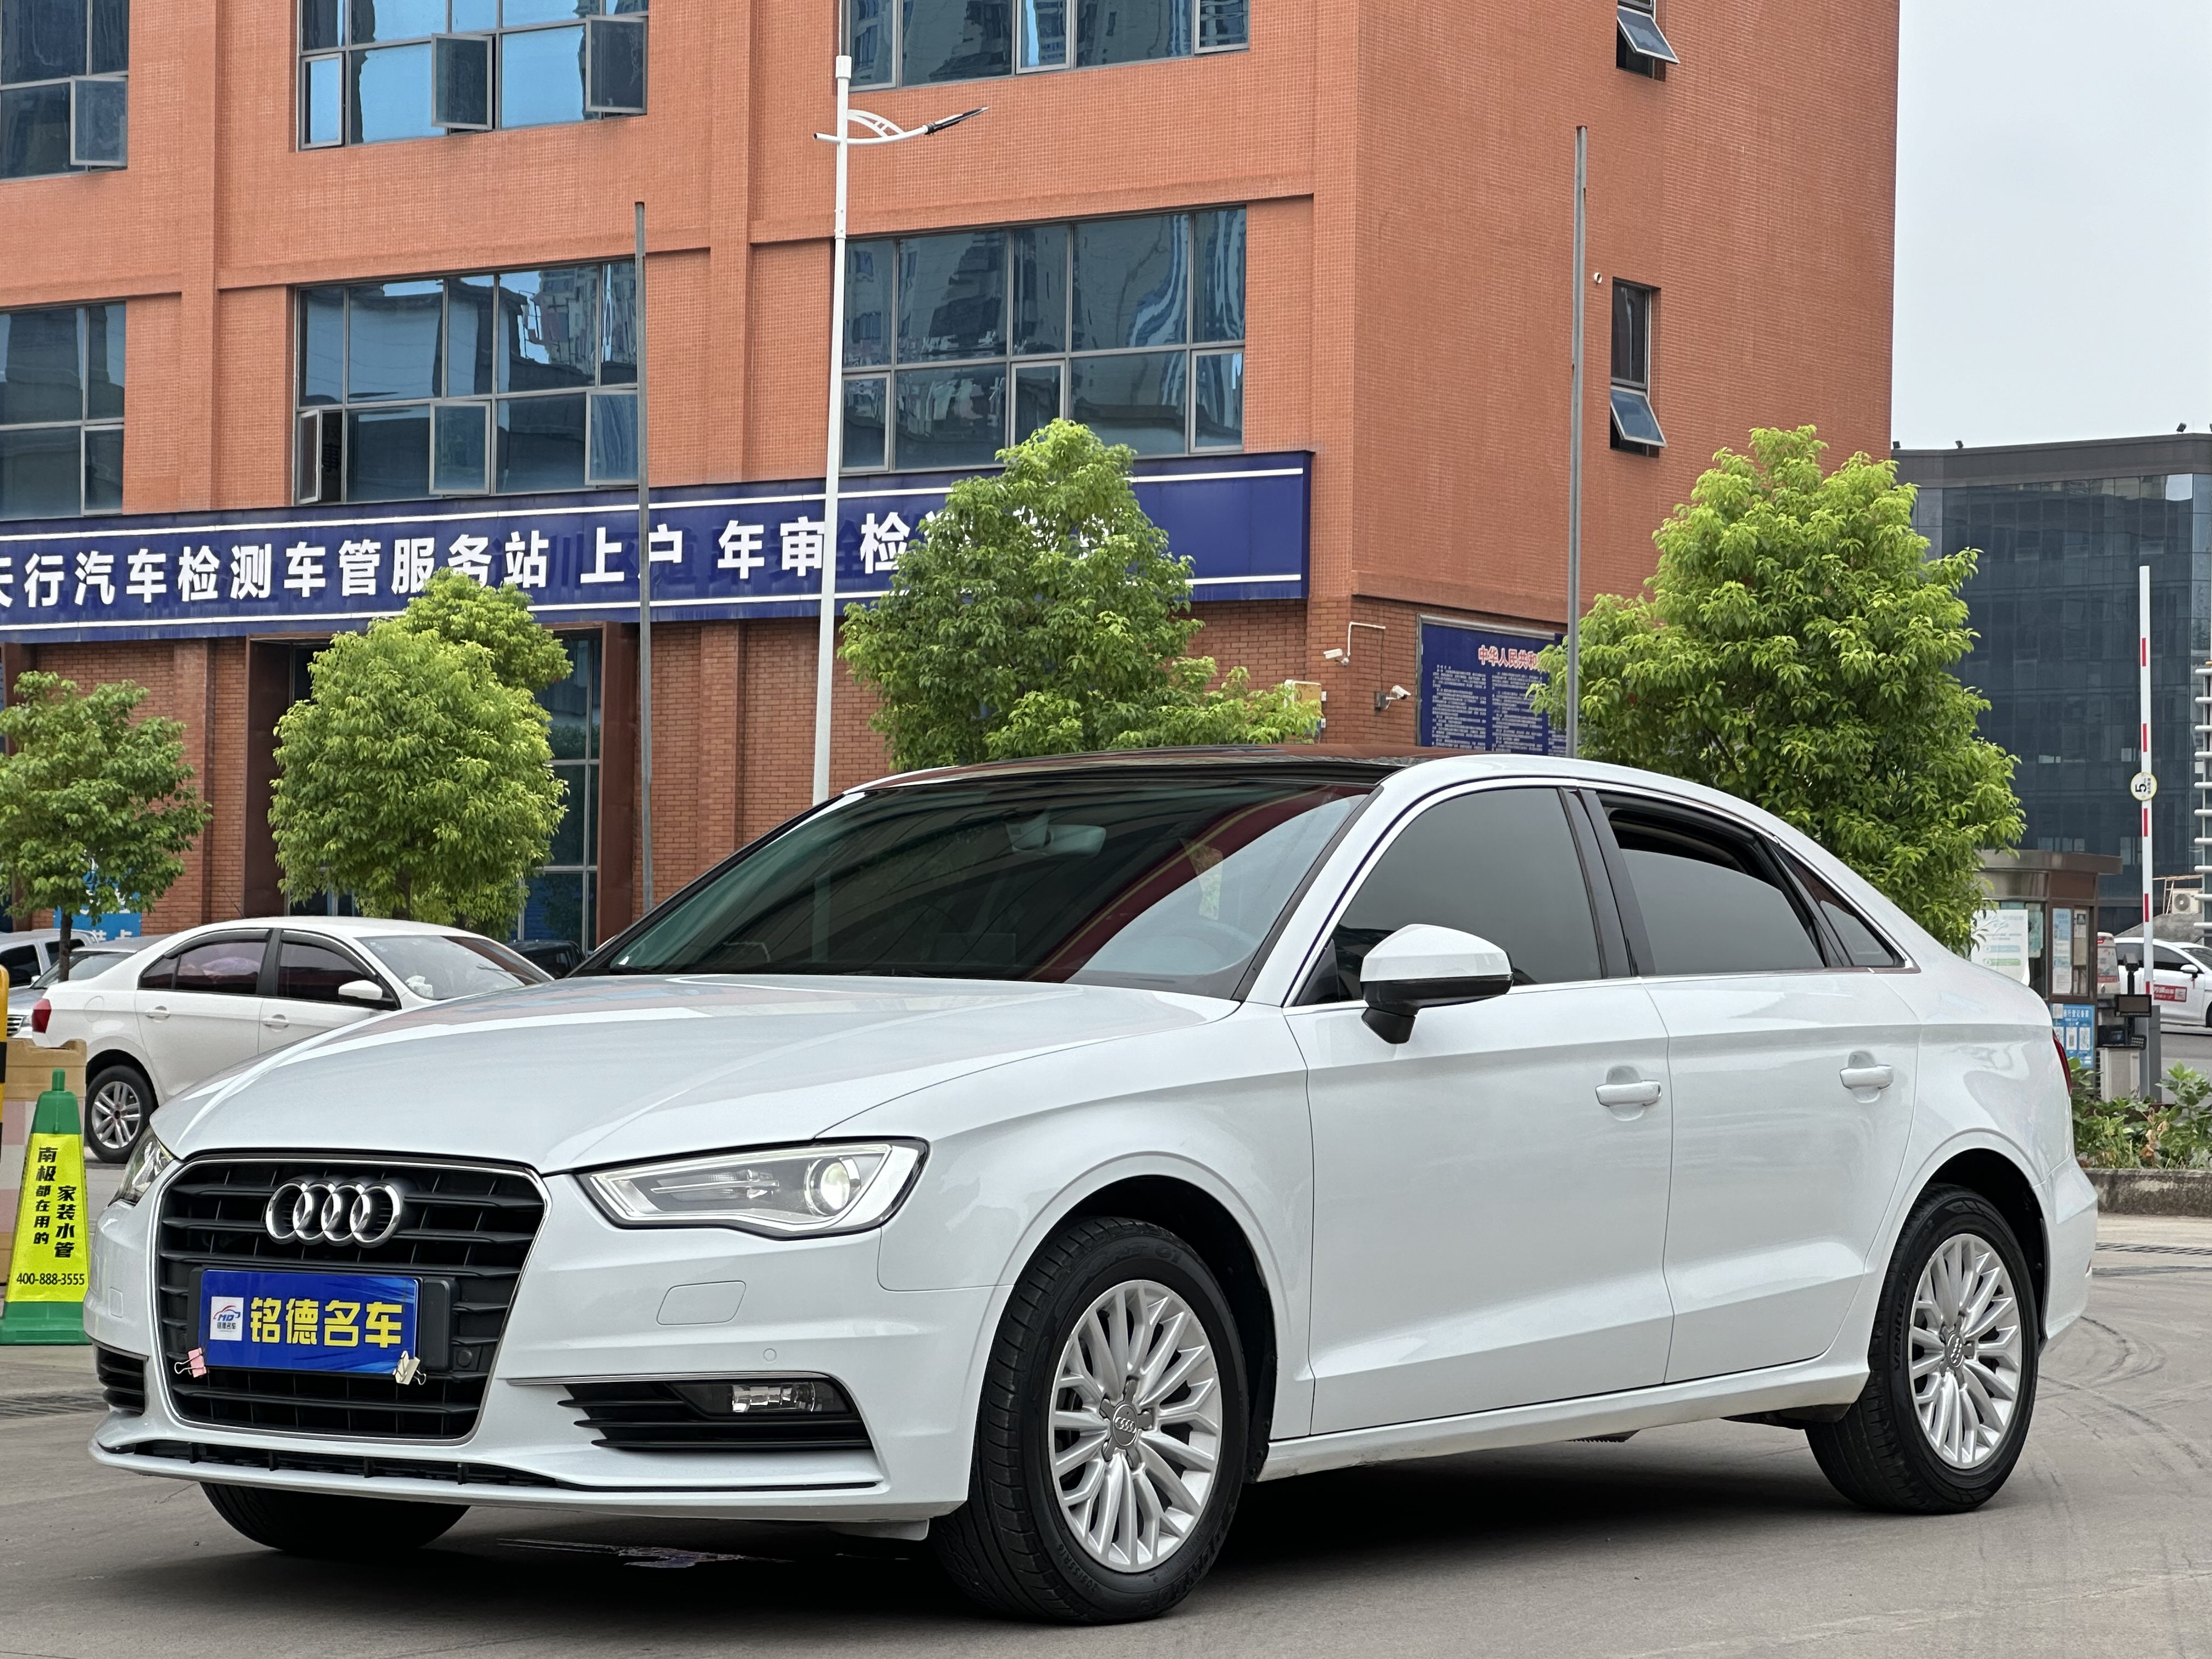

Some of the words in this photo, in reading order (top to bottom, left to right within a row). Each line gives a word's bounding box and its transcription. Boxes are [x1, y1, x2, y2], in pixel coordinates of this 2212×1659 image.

[580, 524, 683, 584] 上户
[717, 516, 825, 579] 年审
[1478, 644, 1549, 672] 中华人民共和
[2135, 783, 2147, 792] 5
[33, 1147, 58, 1245] 南极都在用的
[54, 1185, 77, 1258] 家装水管
[16, 1272, 85, 1286] 400-888-3555
[250, 1297, 403, 1348] 铭德名车
